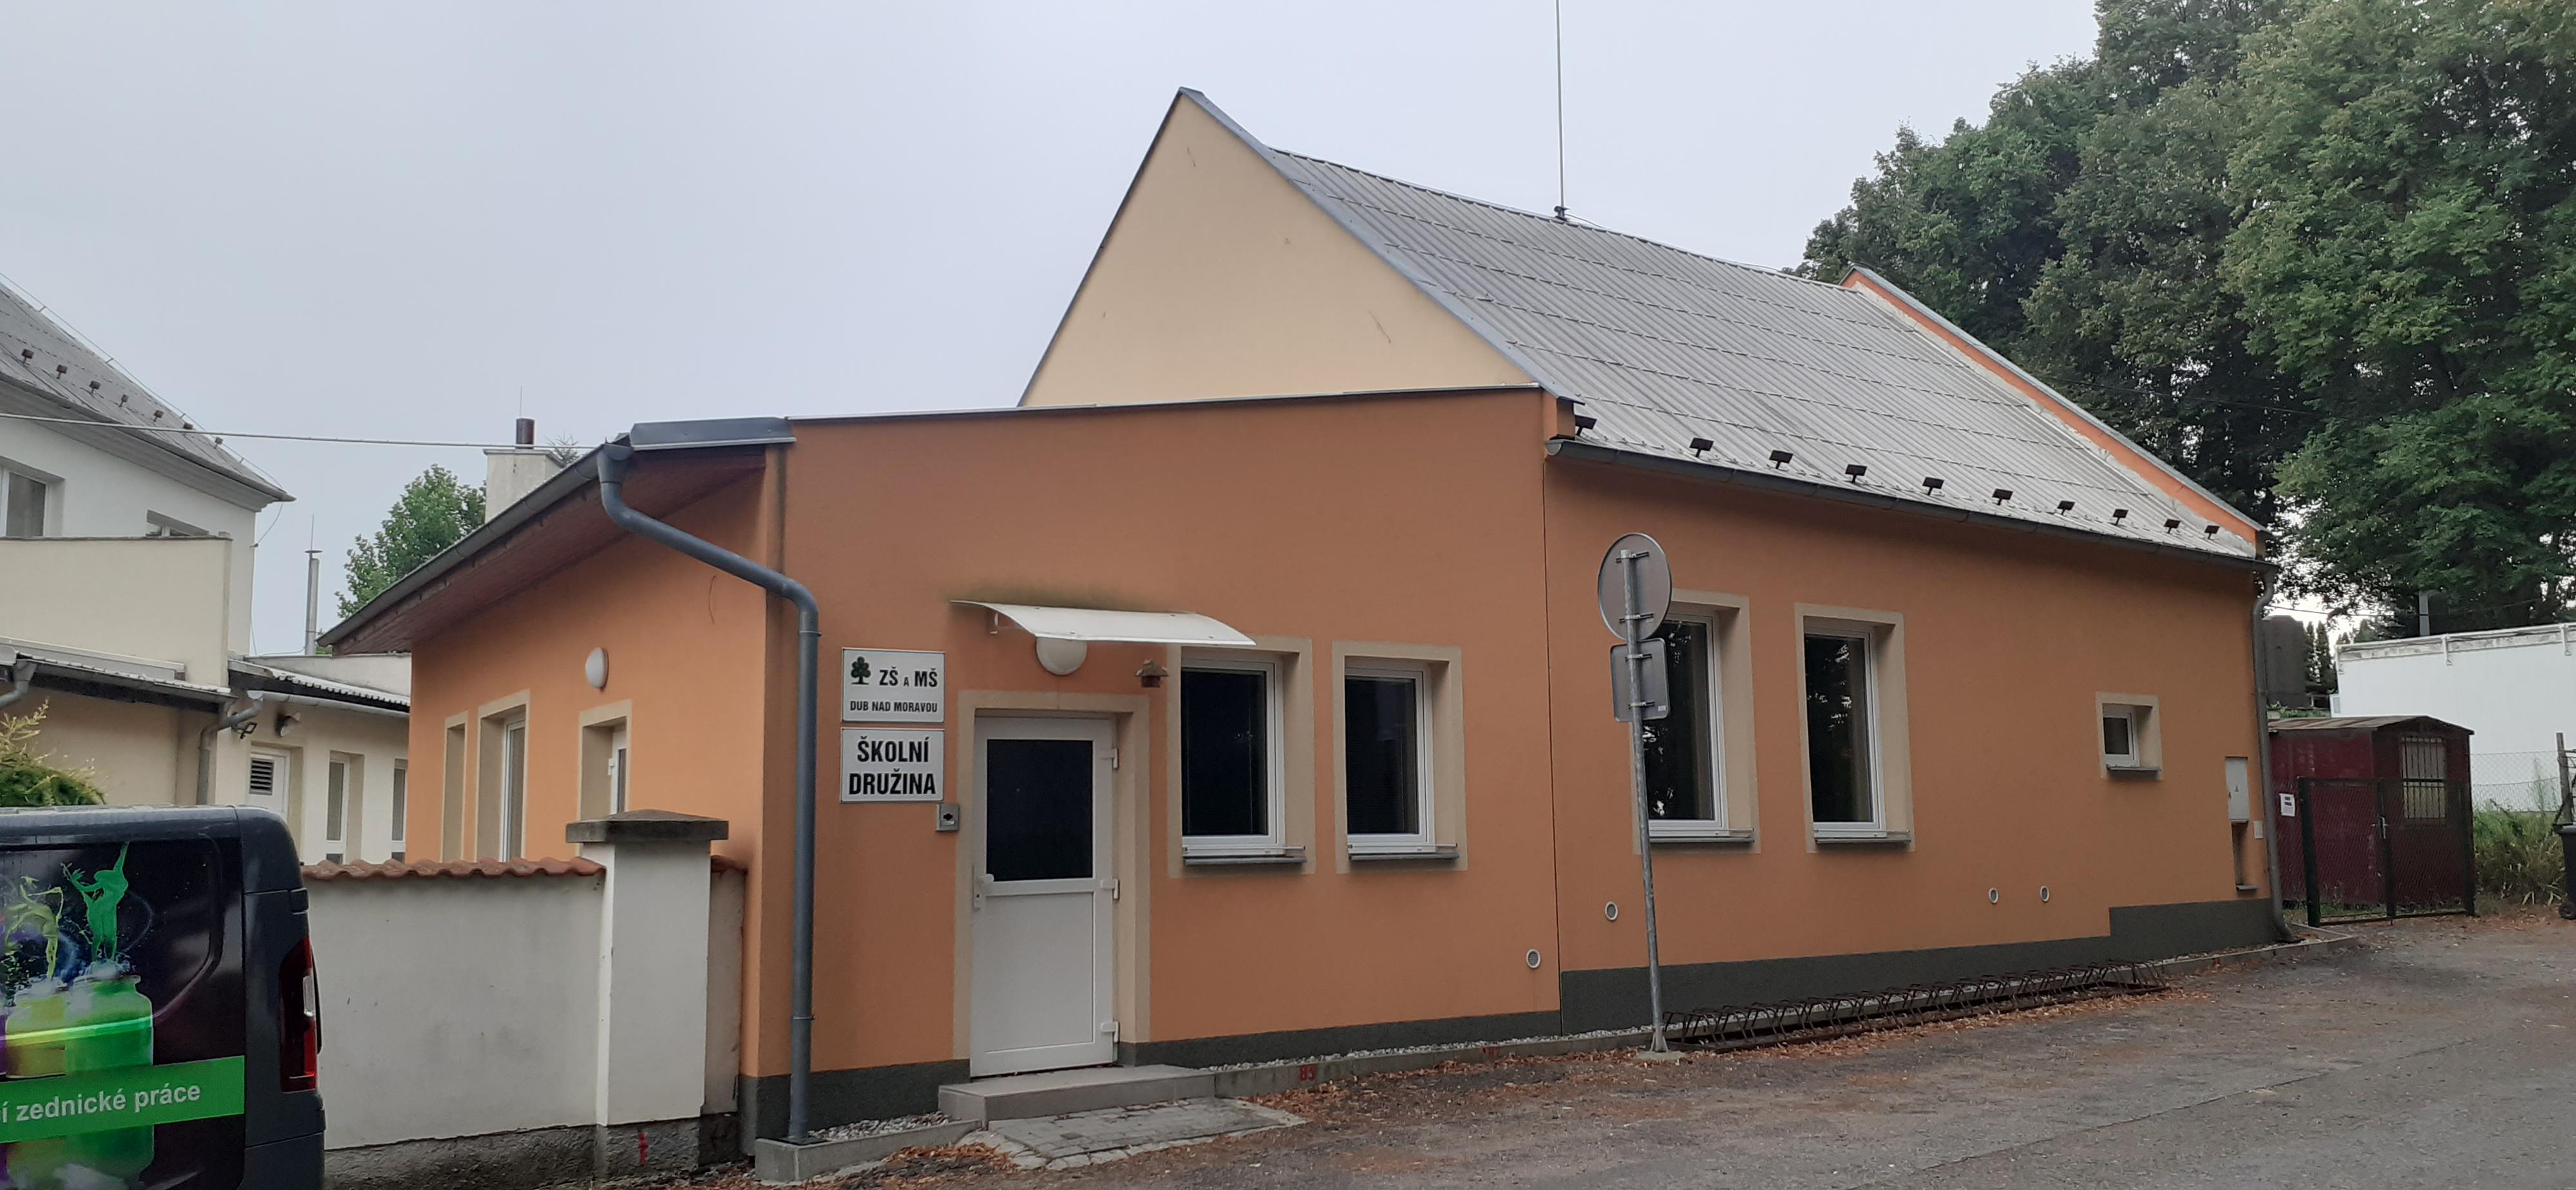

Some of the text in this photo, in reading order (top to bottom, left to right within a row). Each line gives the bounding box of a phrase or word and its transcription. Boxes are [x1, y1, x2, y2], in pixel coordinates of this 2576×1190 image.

[879, 666, 898, 686] ZŠ
[914, 667, 938, 688] MŠ
[850, 701, 938, 713] DUB NAD MORAVOU
[857, 735, 929, 763] ŠKOLNÍ
[849, 768, 936, 795] DRUŽINA
[1, 1082, 201, 1123] í zednické práce
